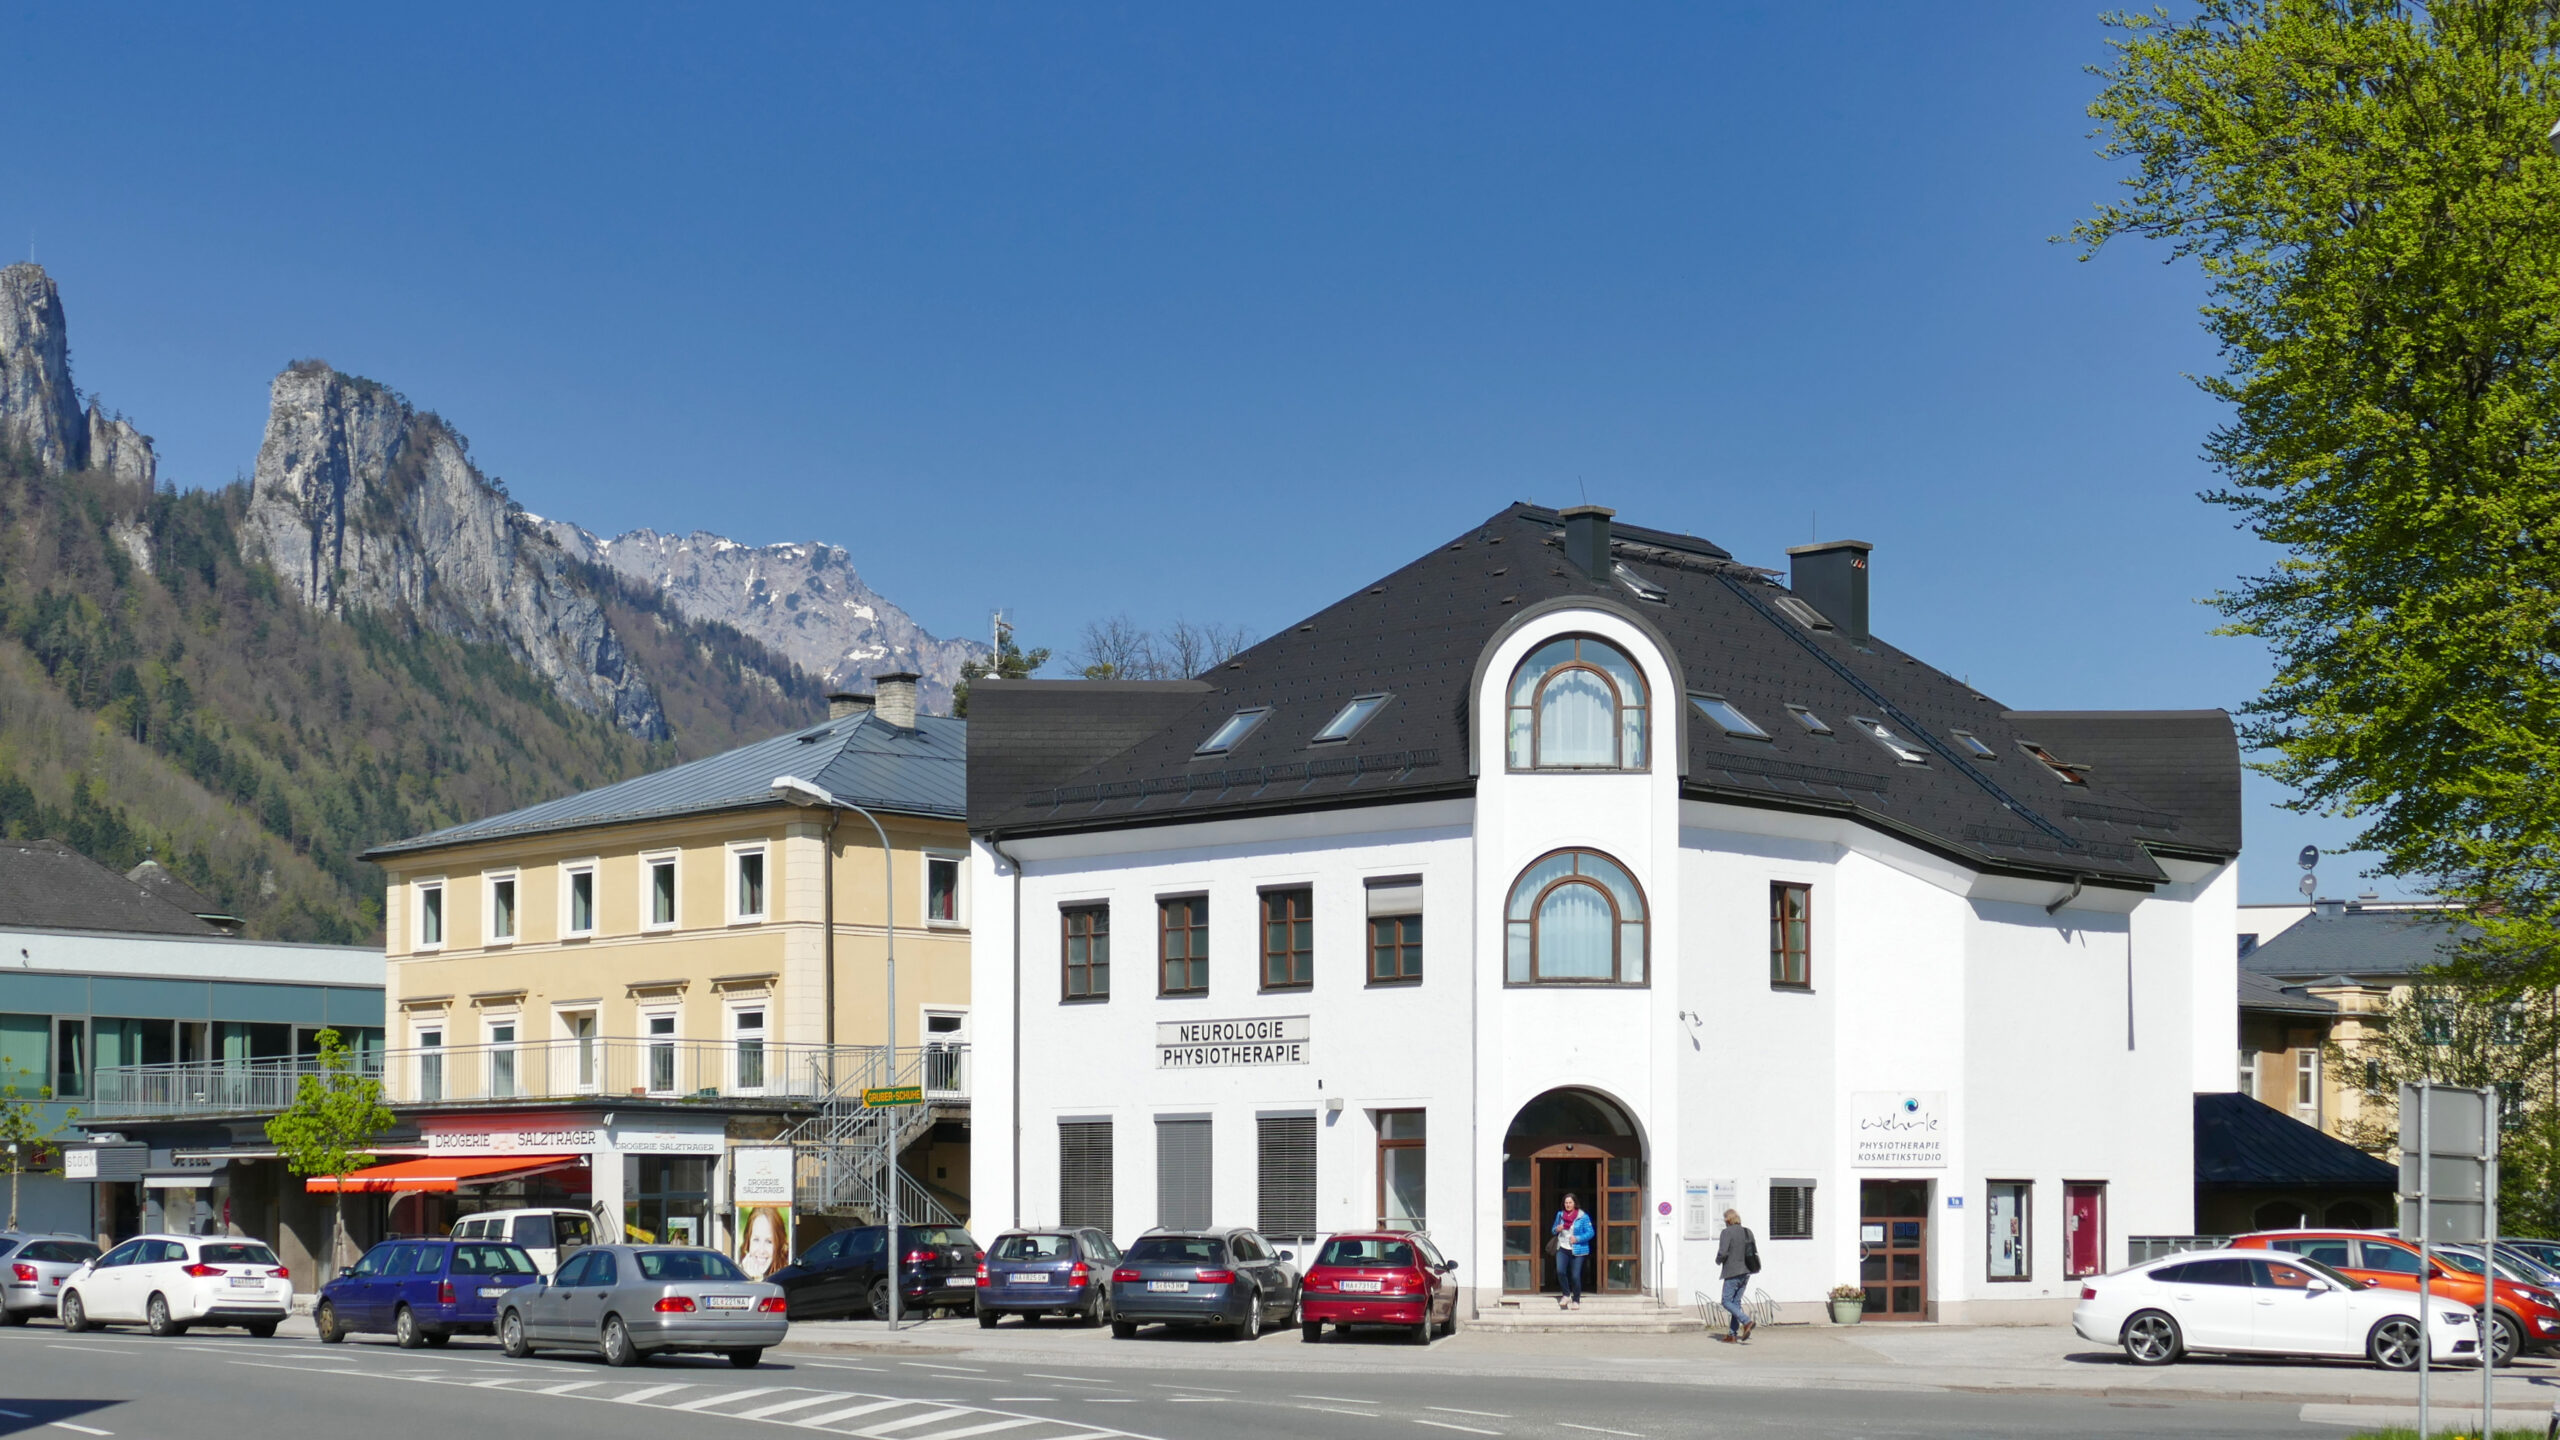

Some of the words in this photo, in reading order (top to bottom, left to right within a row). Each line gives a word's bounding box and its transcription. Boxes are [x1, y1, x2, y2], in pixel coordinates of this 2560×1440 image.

[1180, 1021, 1284, 1042] NEUROLOGIE
[1163, 1044, 1301, 1066] PHYSIOTHERAPIE
[868, 1089, 921, 1103] GRUBER-SCHUHE
[1861, 1112, 1938, 1132] wehrle
[435, 1133, 490, 1148] DROGERIE
[615, 1142, 658, 1151] DROGERIE
[1859, 1141, 1941, 1150] PHYSIOTHERAPIE
[1857, 1152, 1942, 1161] KOSMETIKSTUDIO
